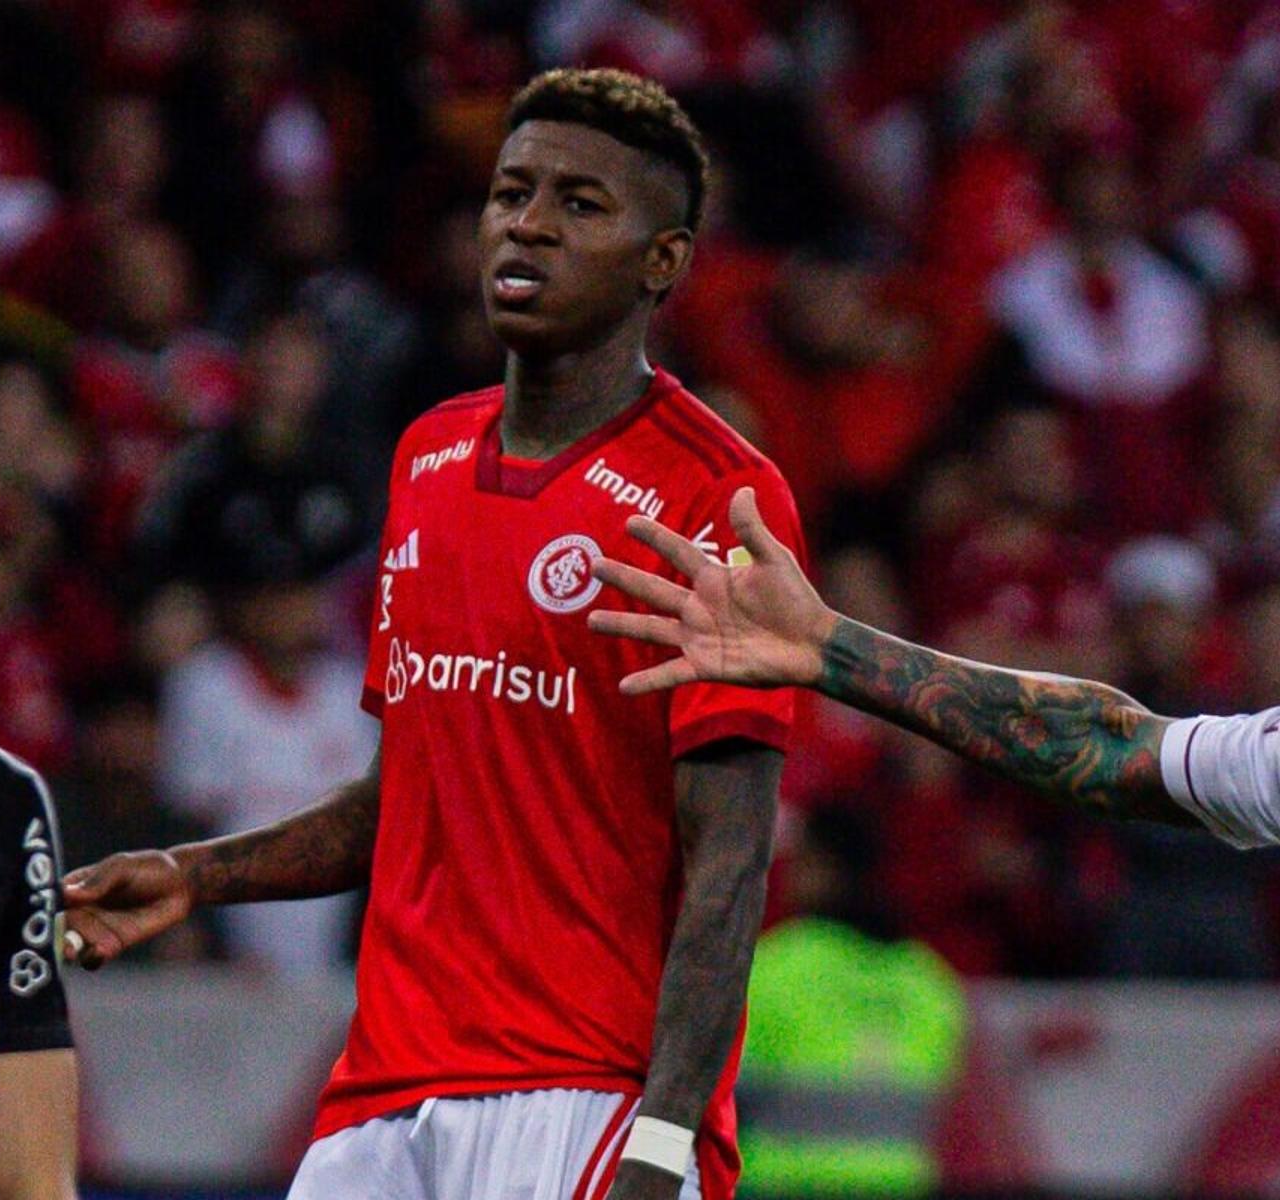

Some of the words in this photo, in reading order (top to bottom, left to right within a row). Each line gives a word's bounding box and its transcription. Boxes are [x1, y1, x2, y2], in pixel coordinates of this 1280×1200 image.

[584, 458, 665, 521] imply
[404, 638, 577, 715] banrisul
[22, 817, 56, 949] vero
